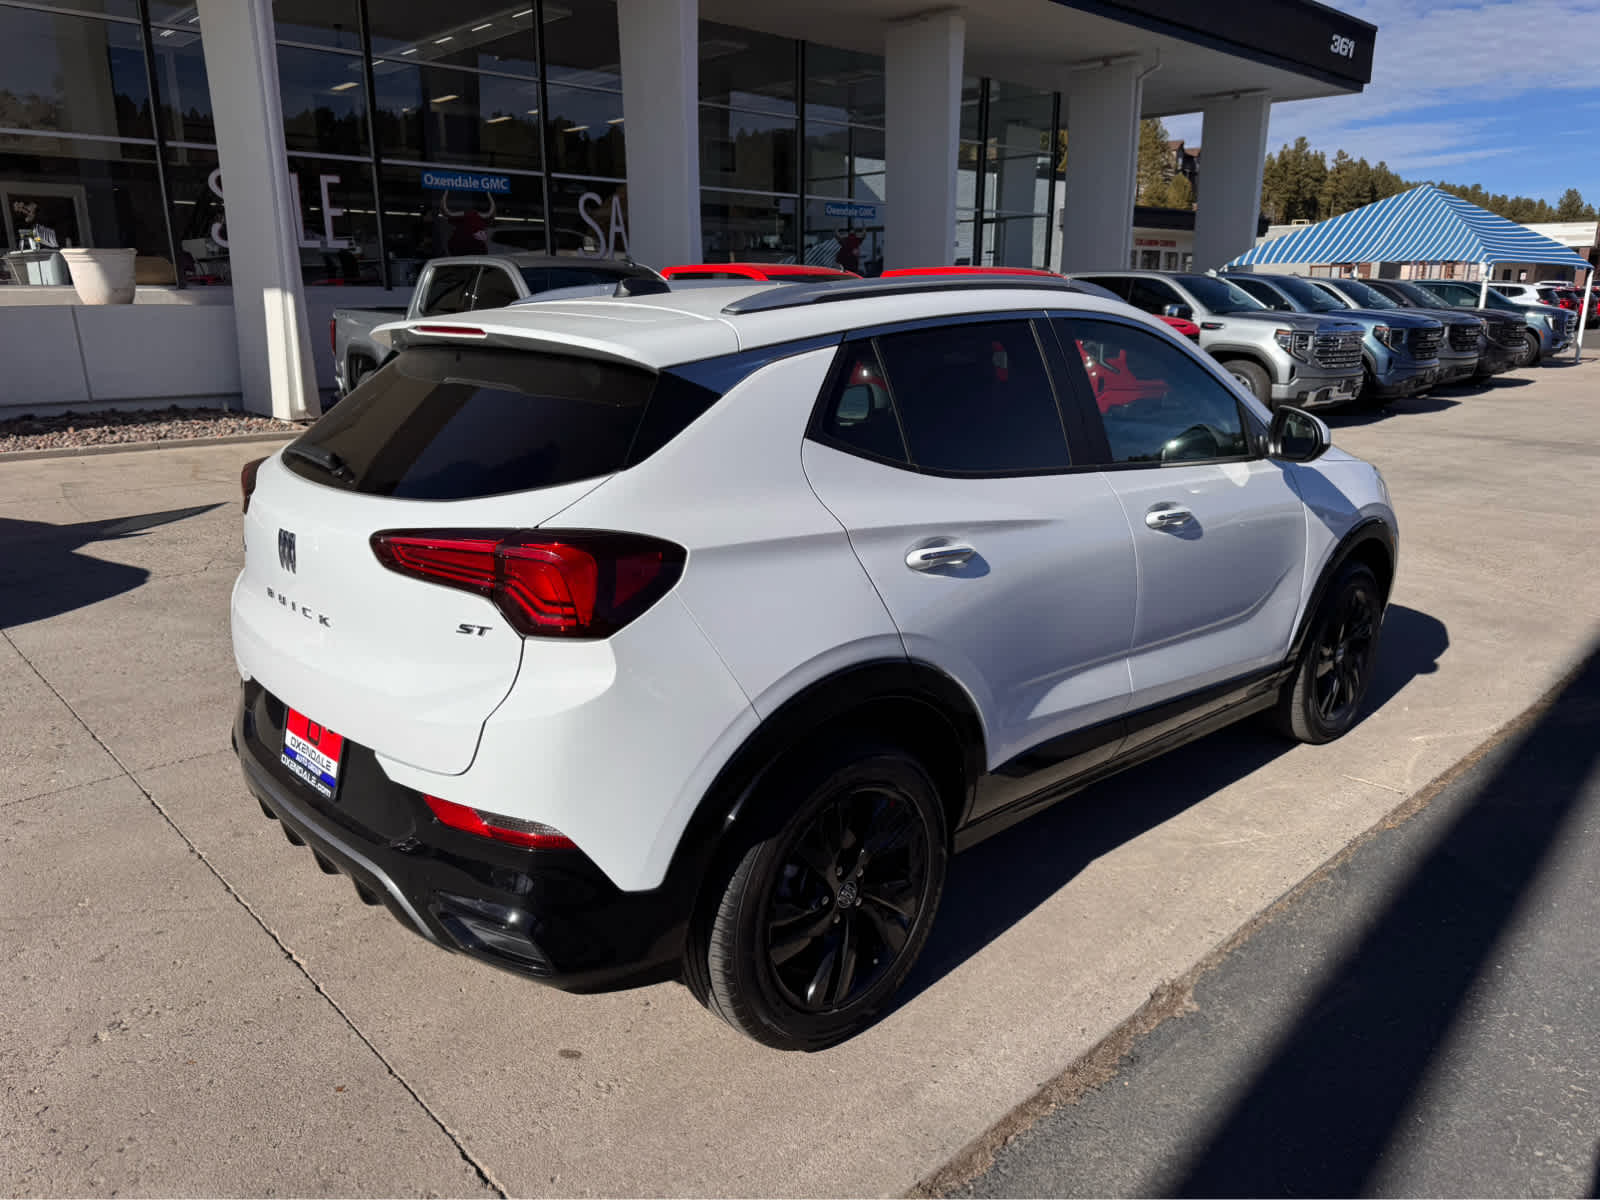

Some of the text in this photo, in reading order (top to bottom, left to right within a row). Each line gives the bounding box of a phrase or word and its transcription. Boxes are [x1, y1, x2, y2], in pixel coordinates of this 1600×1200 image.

[1330, 33, 1356, 59] 361
[423, 173, 509, 191] Oxendale GMC
[266, 586, 331, 628] BUICK
[456, 623, 493, 636] ST
[290, 735, 332, 773] OXENDALE
[280, 752, 333, 798] OXENDALE.com
